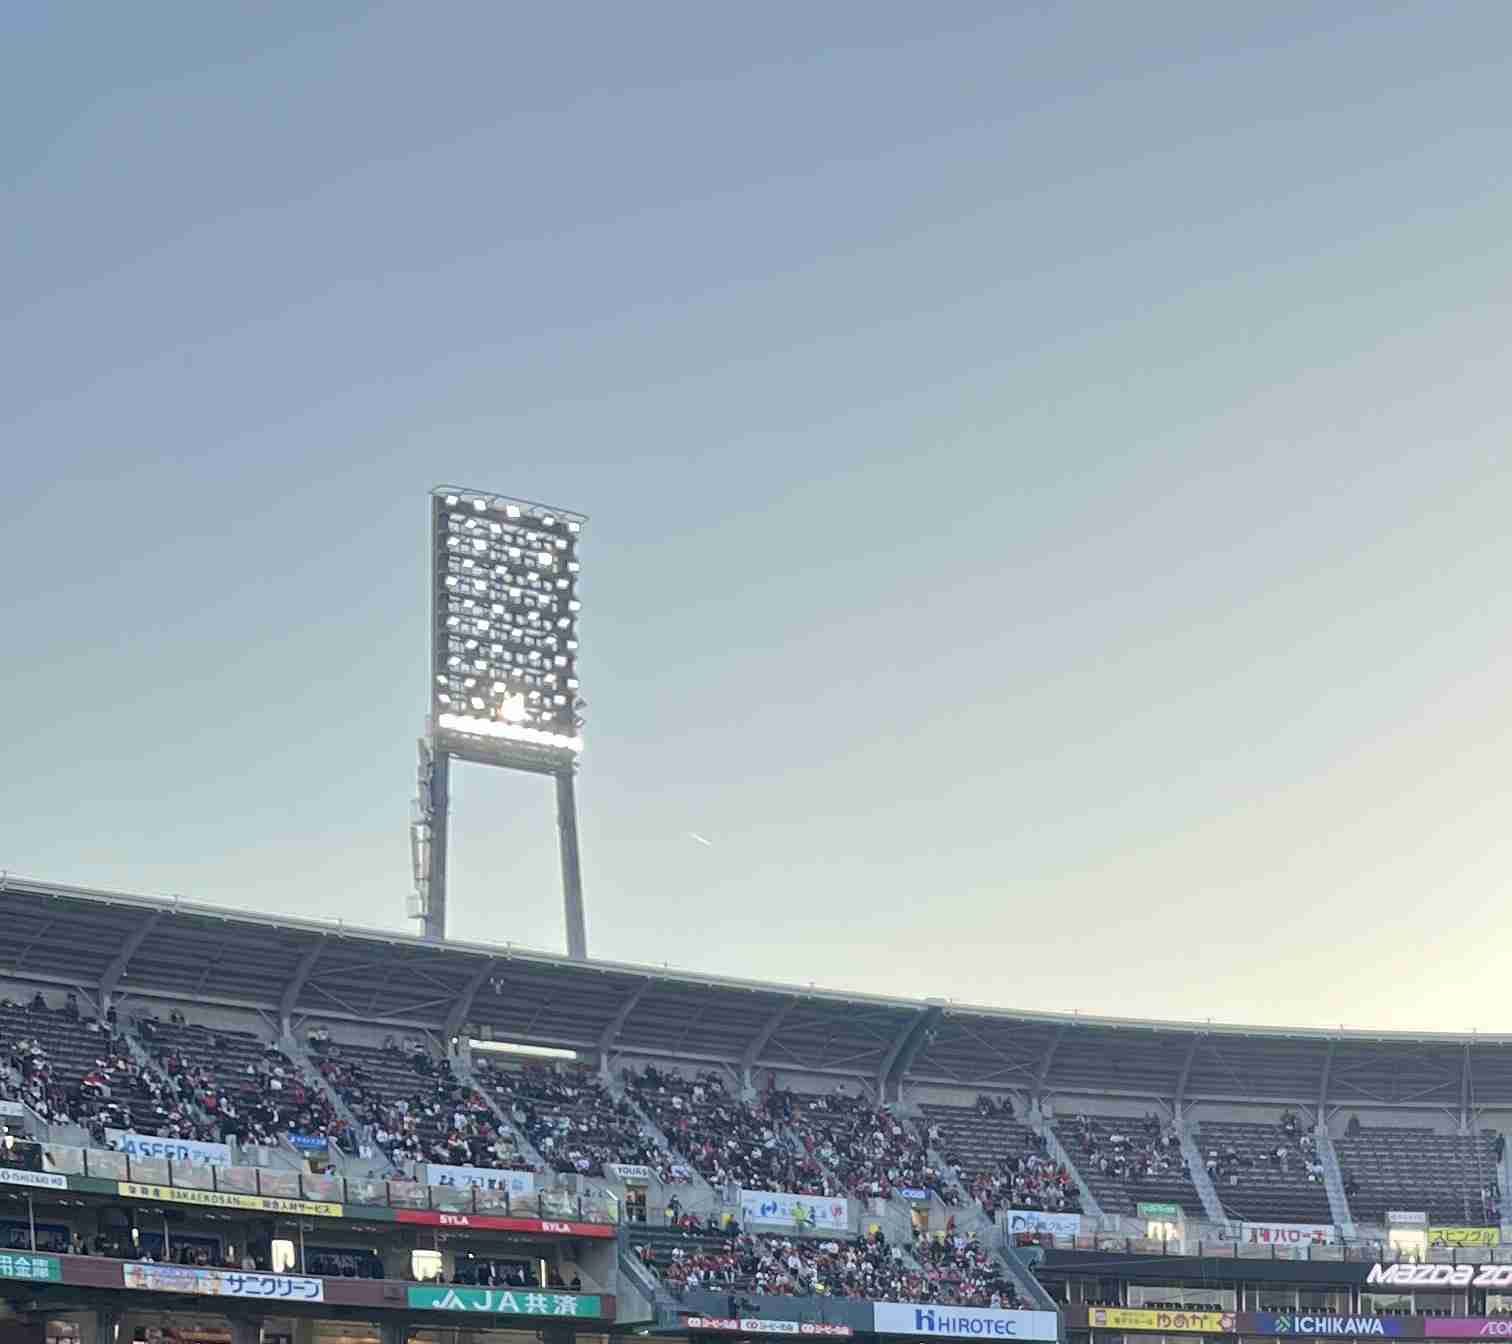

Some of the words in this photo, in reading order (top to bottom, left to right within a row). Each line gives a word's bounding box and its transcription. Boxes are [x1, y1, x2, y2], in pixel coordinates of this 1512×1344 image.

[225, 1275, 320, 1298] サニクリーン
[472, 1290, 578, 1316] JA共済
[938, 1318, 1017, 1336] HIROTEC
[1294, 1316, 1385, 1336] ICHIKAWA
